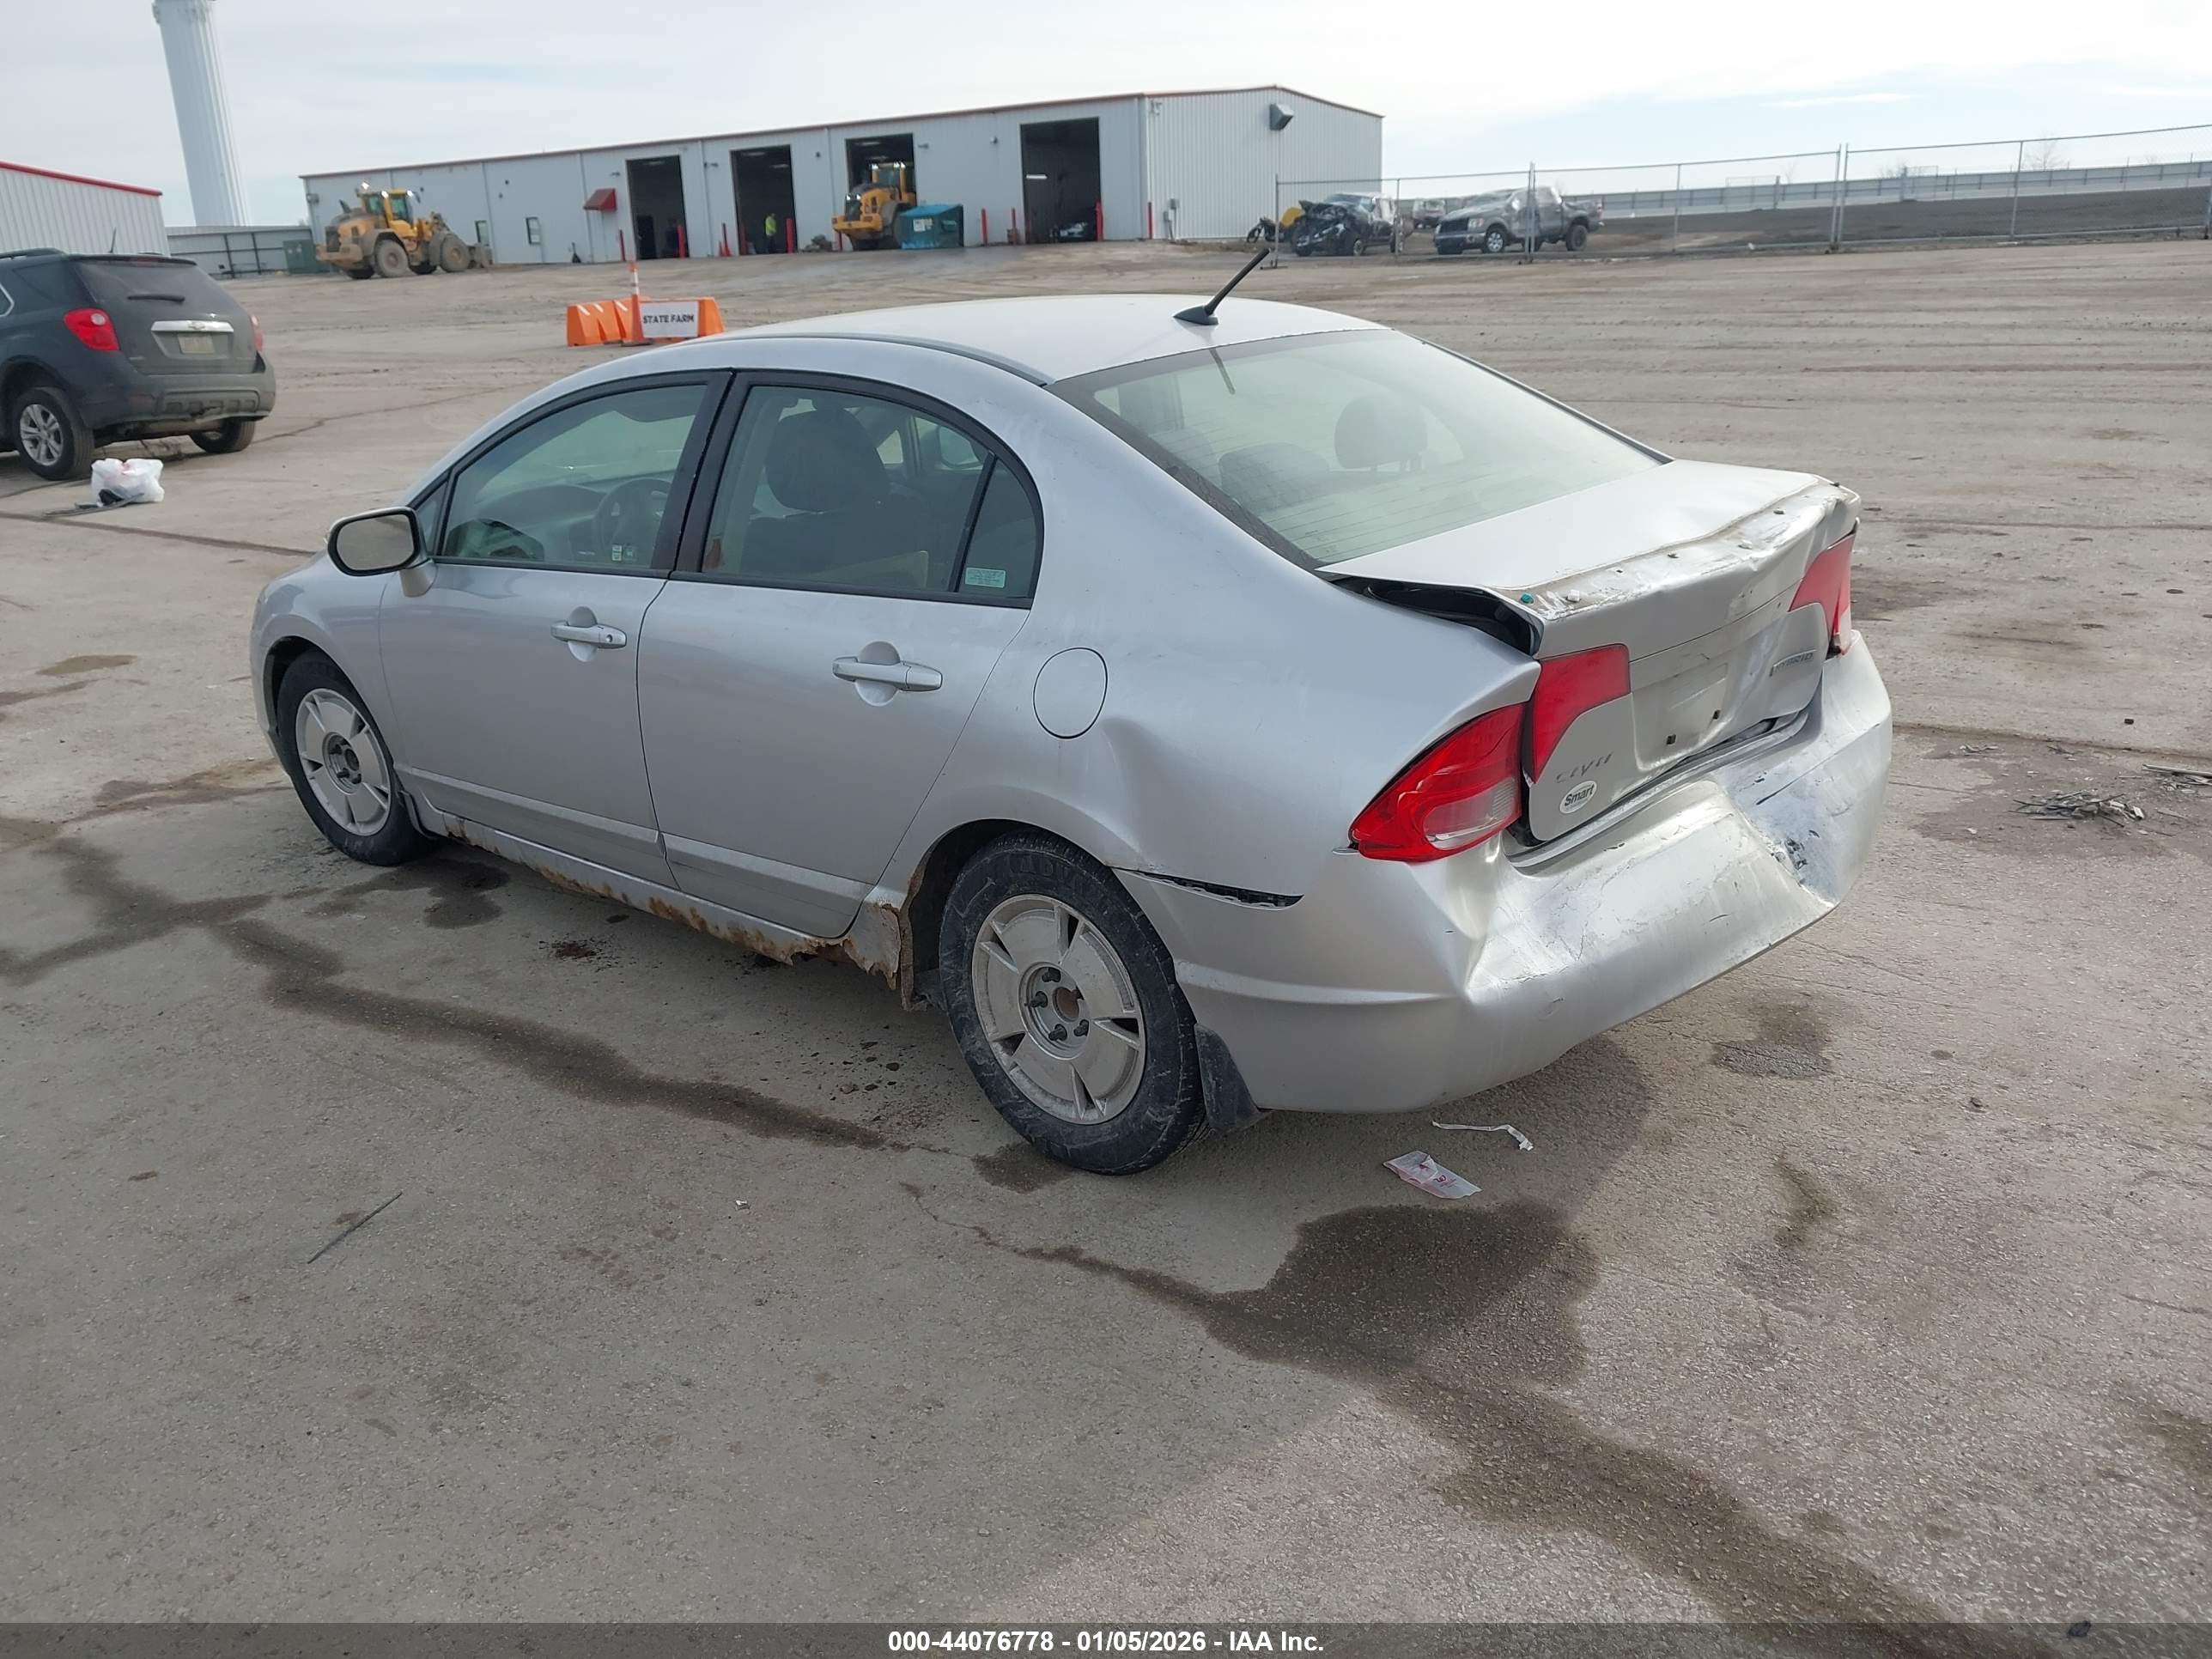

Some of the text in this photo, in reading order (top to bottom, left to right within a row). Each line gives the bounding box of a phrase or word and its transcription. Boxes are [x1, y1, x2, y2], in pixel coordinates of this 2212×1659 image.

[643, 314, 695, 324] STATE FARM
[1565, 784, 1595, 806] Smart
